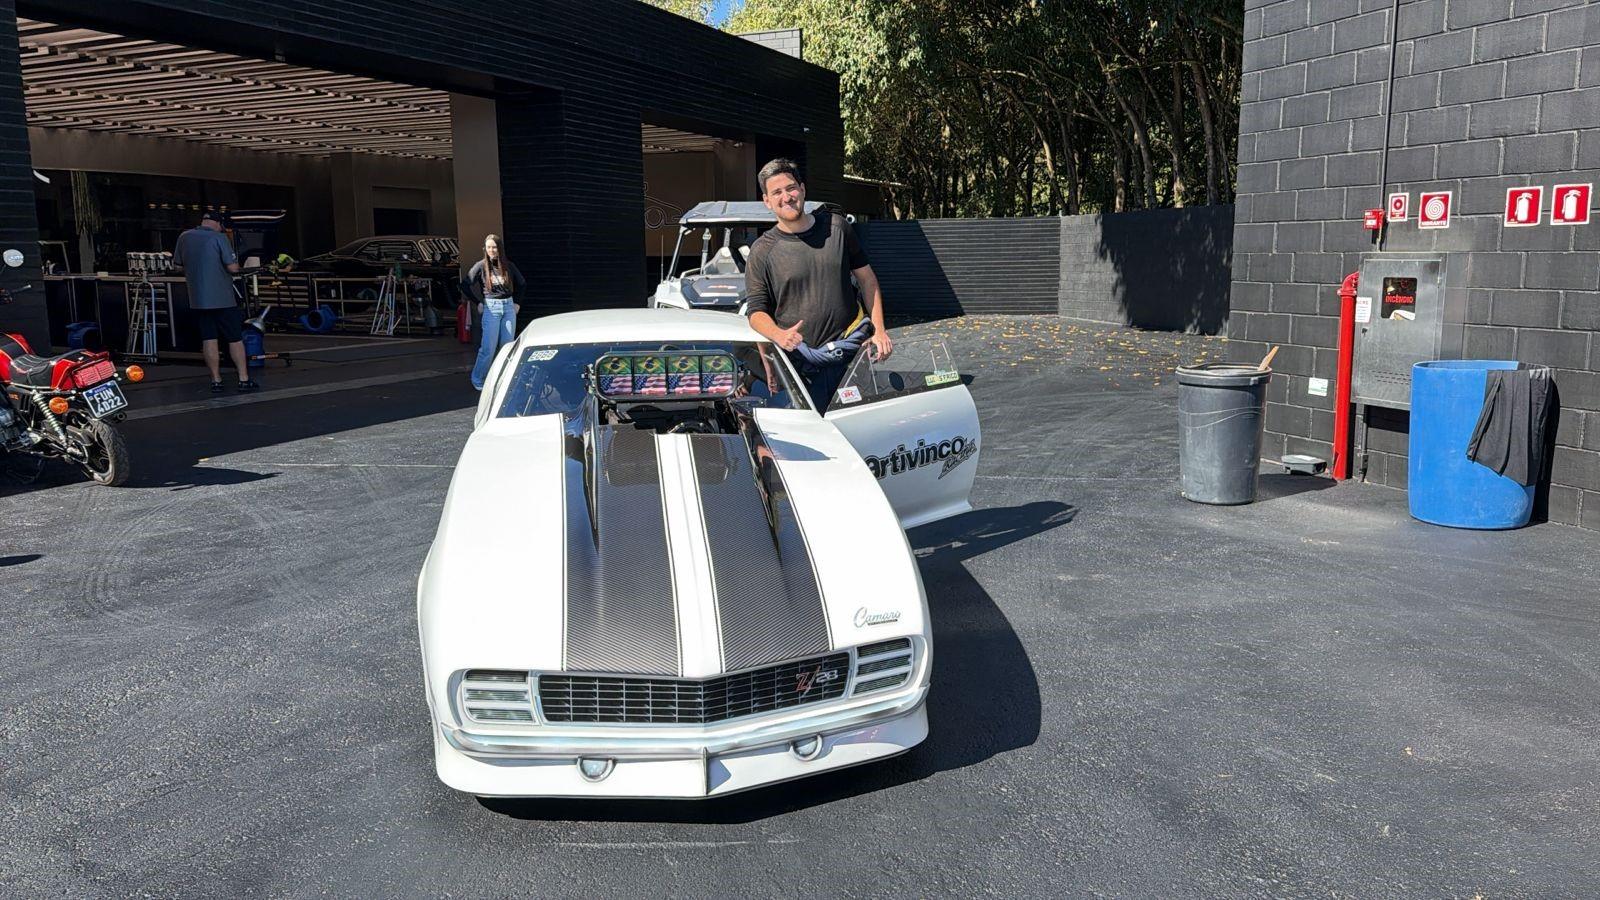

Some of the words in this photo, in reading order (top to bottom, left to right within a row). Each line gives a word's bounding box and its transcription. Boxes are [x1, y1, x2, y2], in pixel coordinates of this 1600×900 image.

[94, 387, 115, 404] FUN
[97, 396, 123, 413] 4D22
[853, 607, 901, 628] Camaro
